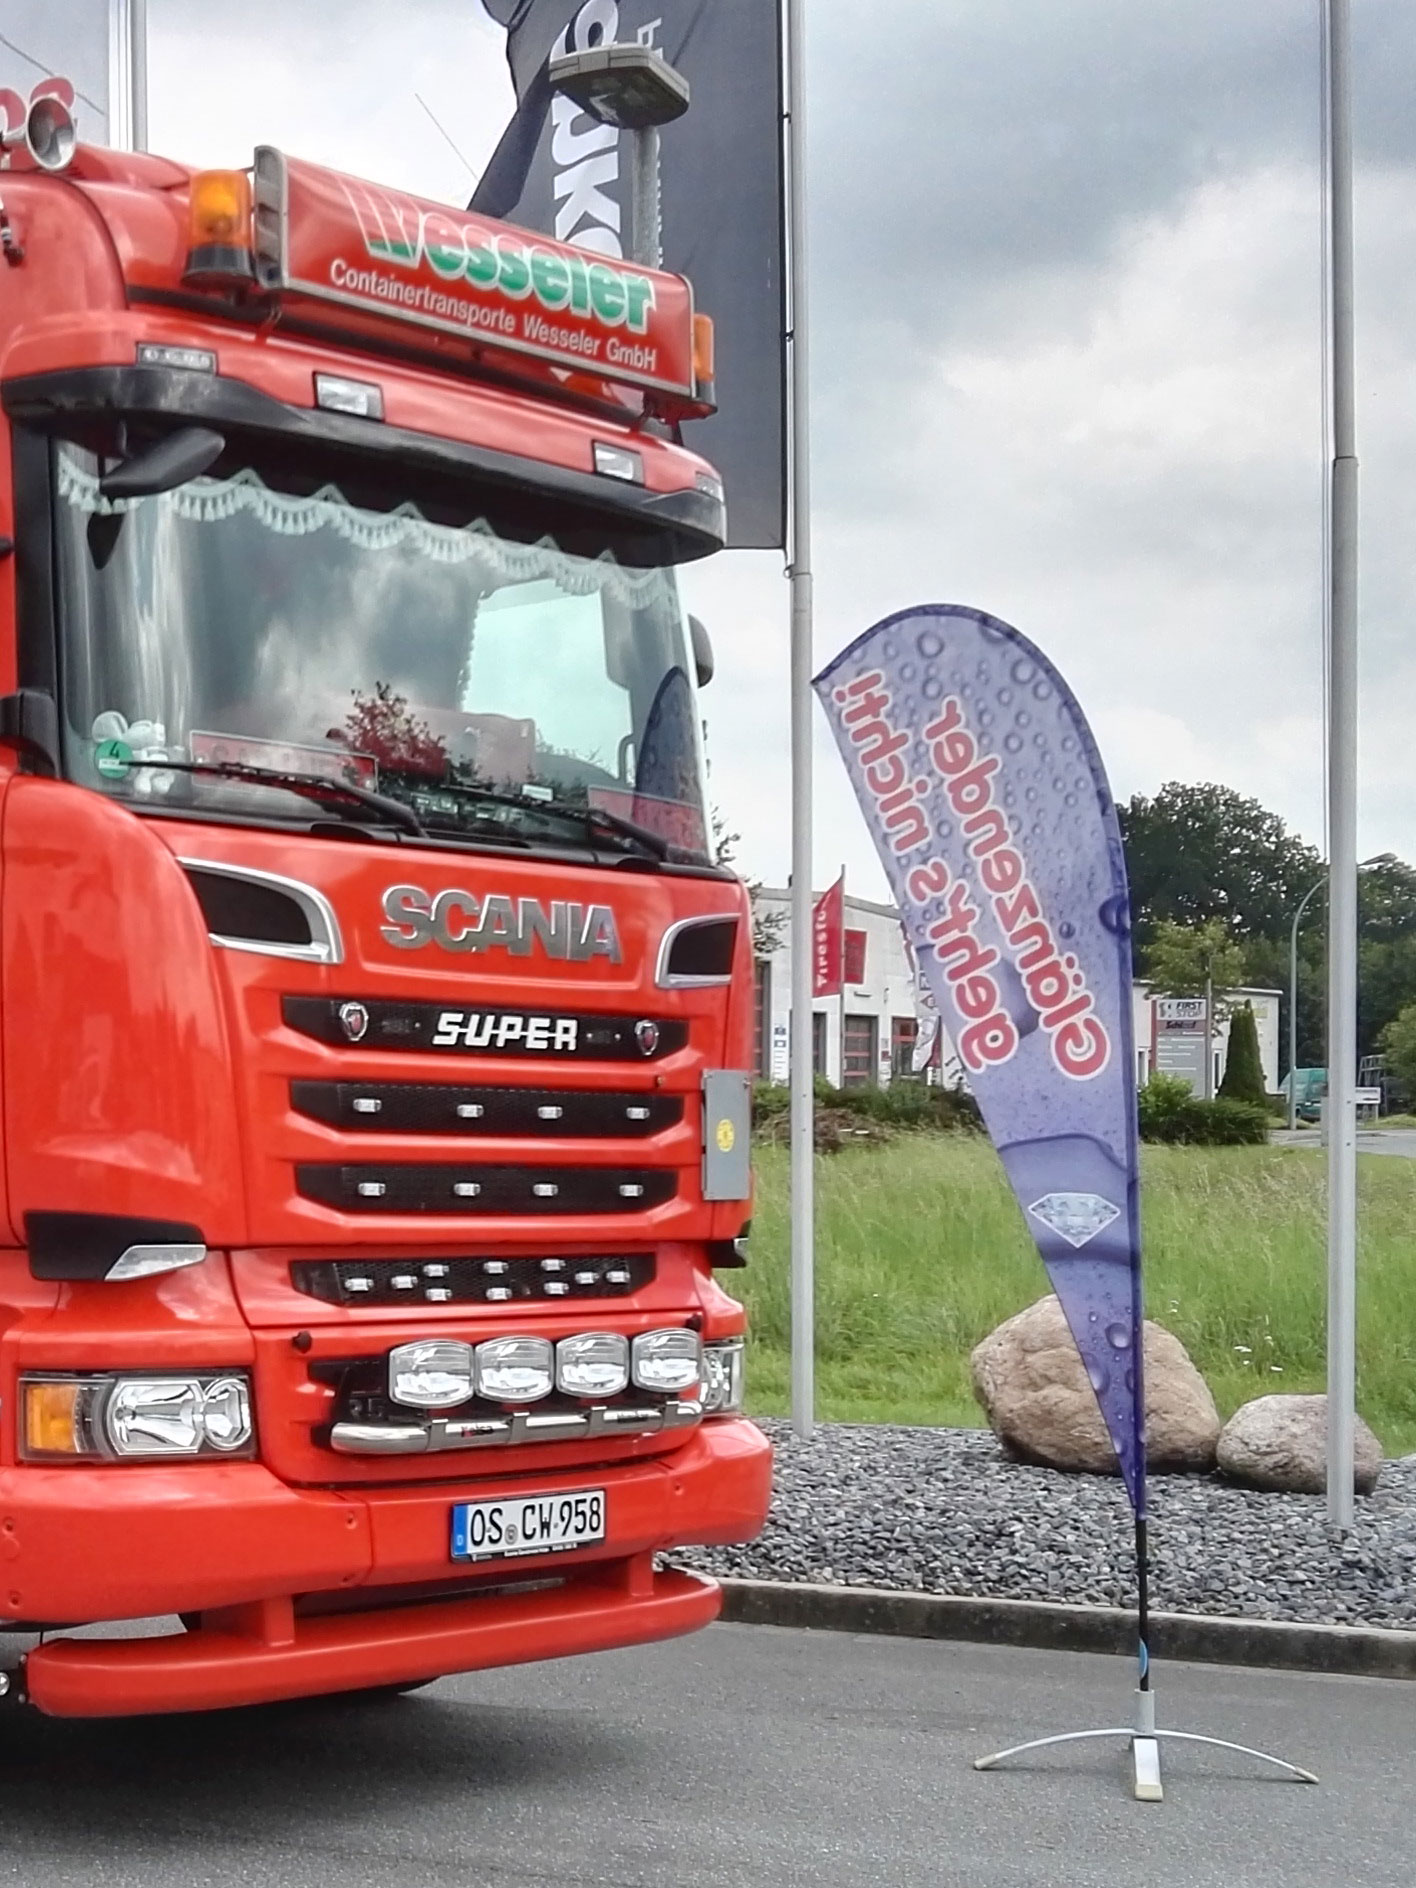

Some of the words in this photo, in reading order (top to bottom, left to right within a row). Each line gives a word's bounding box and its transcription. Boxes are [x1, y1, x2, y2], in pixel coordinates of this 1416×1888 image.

[338, 174, 656, 334] Wesseler
[330, 258, 516, 333] Containertransporte
[523, 313, 600, 356] Wesseler
[605, 338, 657, 371] GmbH
[109, 741, 120, 759] 4
[380, 884, 623, 964] SCANIA
[432, 1012, 578, 1050] SUPER
[471, 1508, 503, 1546] OS
